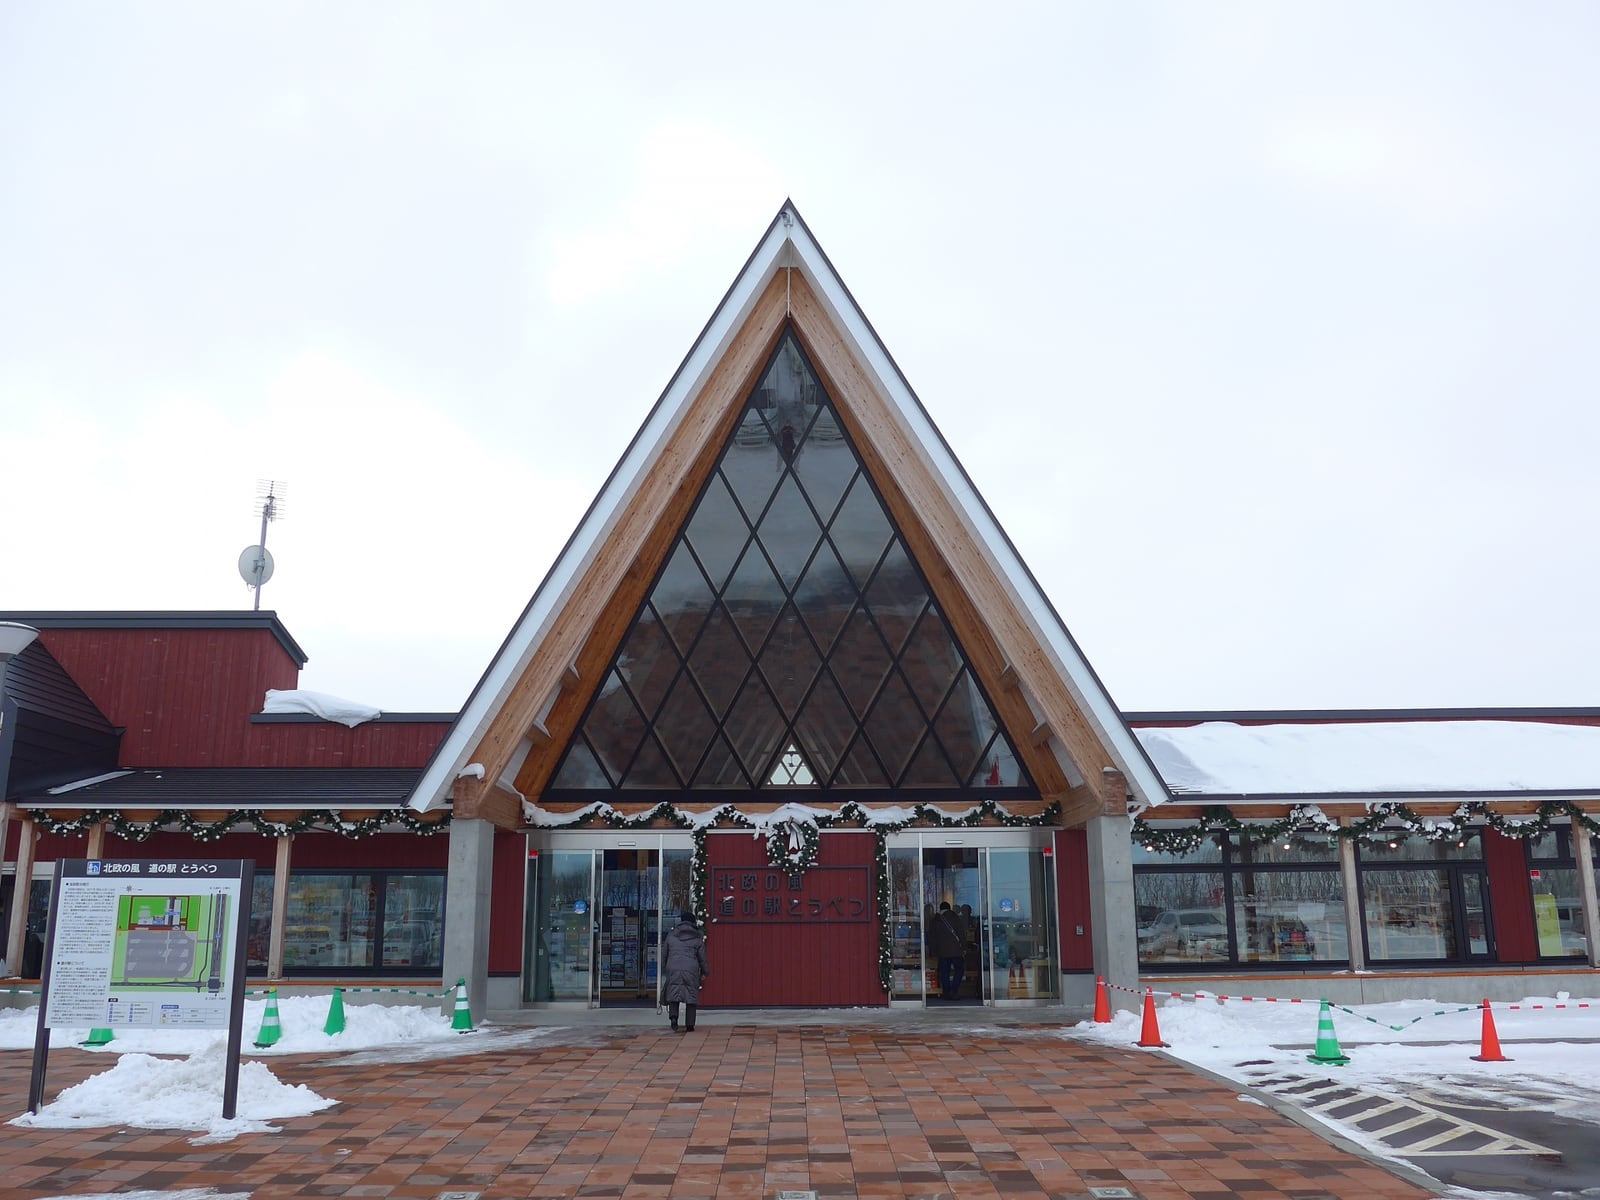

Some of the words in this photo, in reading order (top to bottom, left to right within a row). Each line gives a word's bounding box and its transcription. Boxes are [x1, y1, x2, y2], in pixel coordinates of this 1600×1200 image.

[103, 863, 140, 873] 北欧の風
[148, 863, 177, 873] 道の駅
[180, 864, 218, 873] とうべつ
[719, 873, 803, 891] 北欧の風
[719, 896, 865, 916] 道の駅とうべつ
